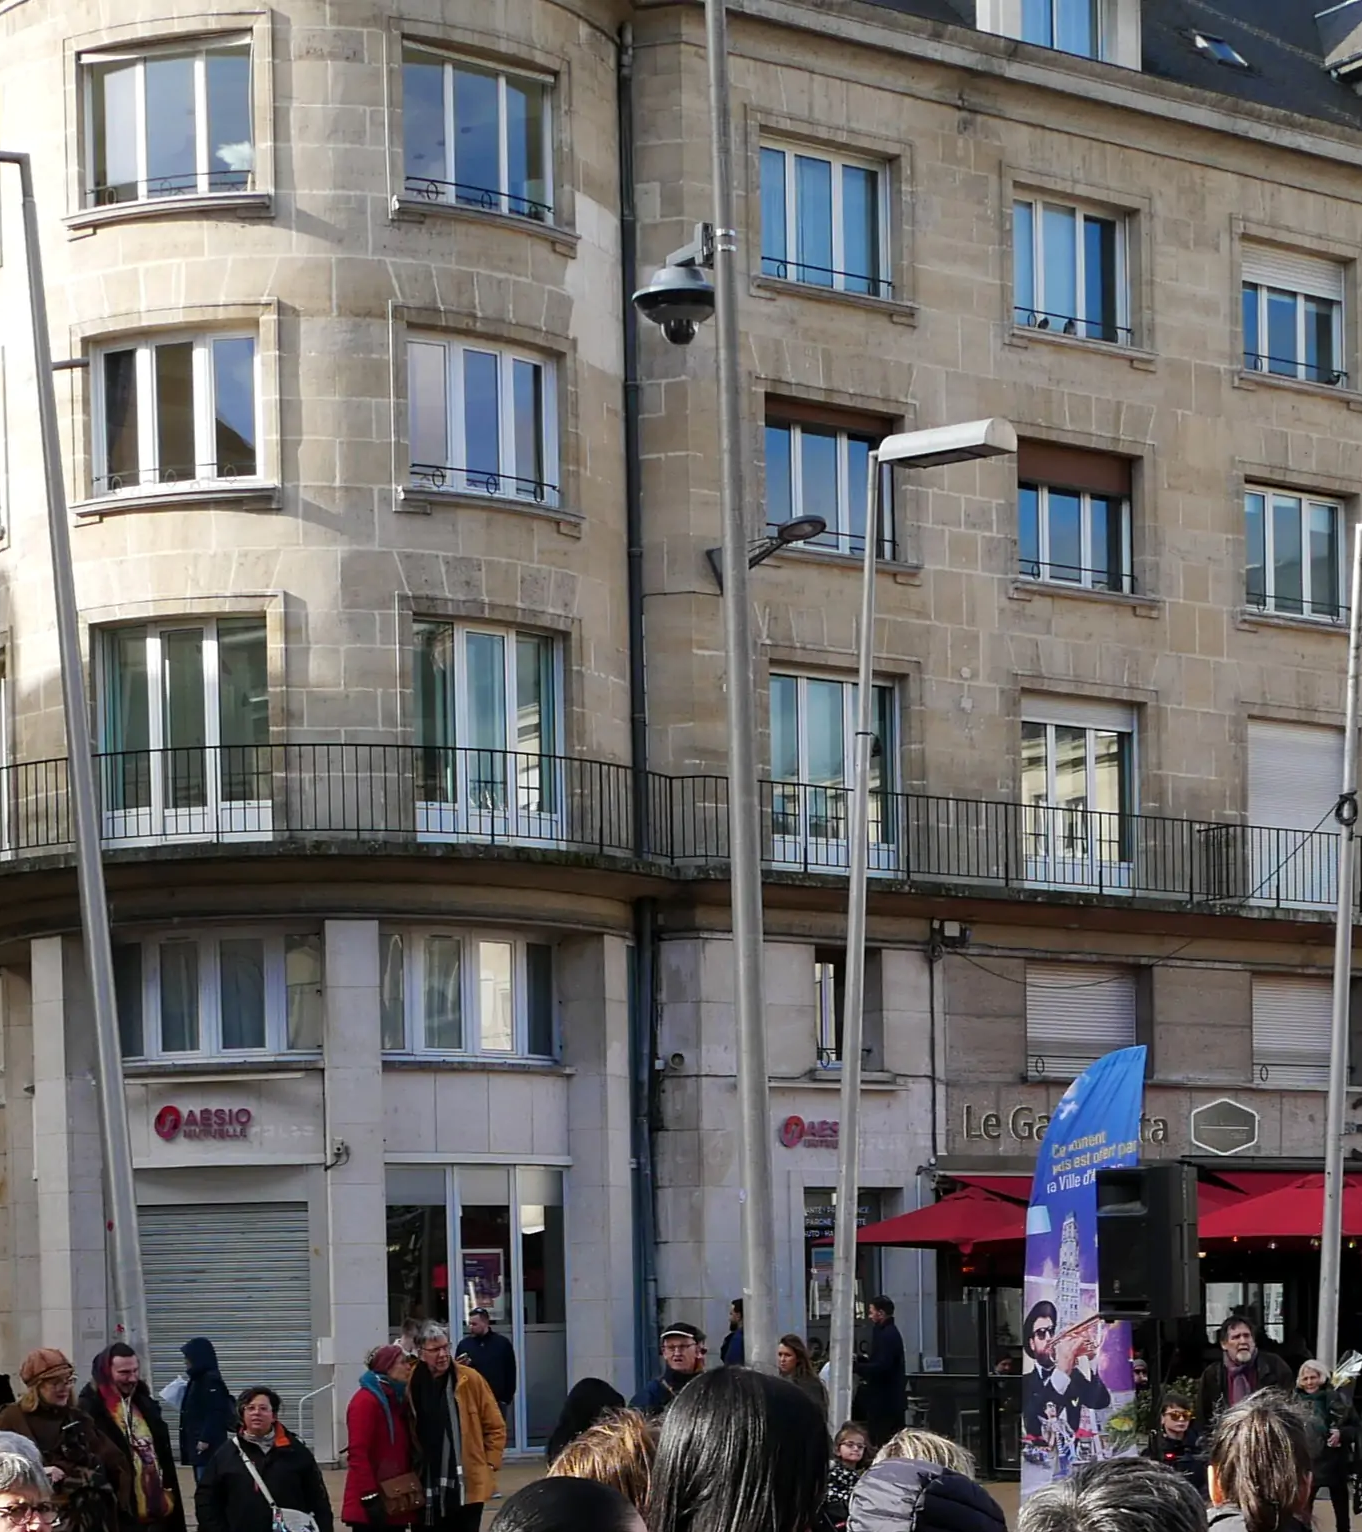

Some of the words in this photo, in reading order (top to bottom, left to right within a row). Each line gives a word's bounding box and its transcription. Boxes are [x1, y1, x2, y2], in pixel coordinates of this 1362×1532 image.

[182, 1106, 252, 1127] AÉSIO
[963, 1103, 1003, 1142] Le
[182, 1126, 248, 1140] MUTUELLE
[1073, 1152, 1091, 1168] est
[1118, 1140, 1138, 1160] par
[1059, 1172, 1081, 1191] Ville
